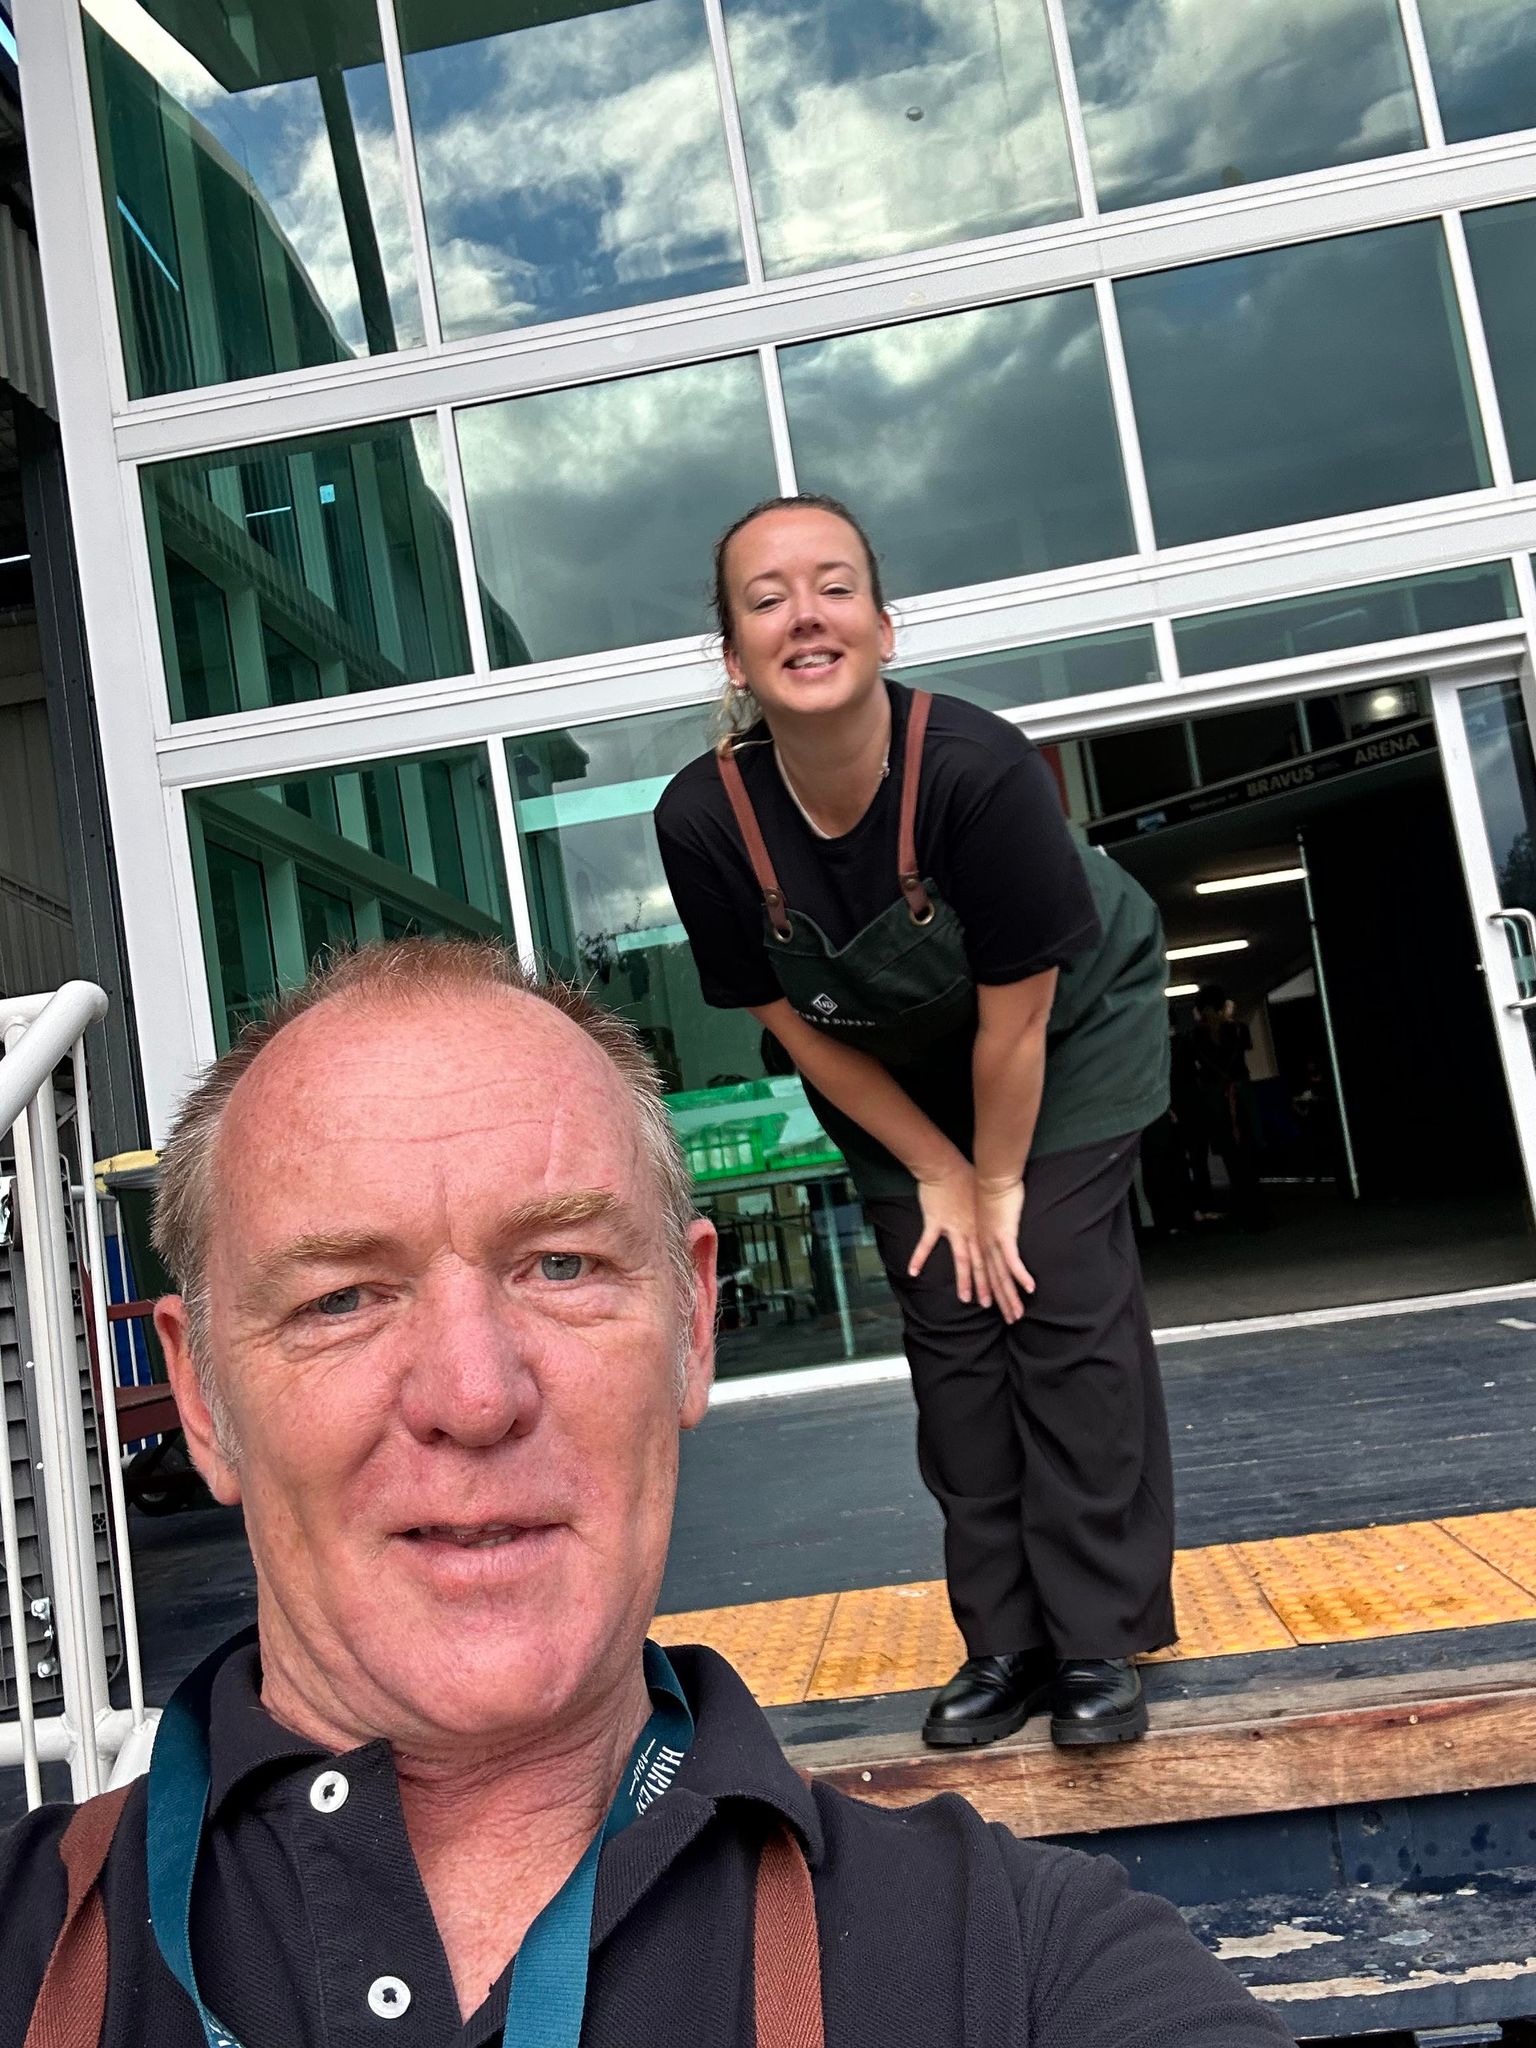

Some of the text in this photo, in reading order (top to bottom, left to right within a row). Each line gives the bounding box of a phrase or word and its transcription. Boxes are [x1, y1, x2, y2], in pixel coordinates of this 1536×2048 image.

[1246, 765, 1315, 799] BRAVUS
[1354, 732, 1420, 765] ARENA
[633, 1752, 649, 1782] ROAD
